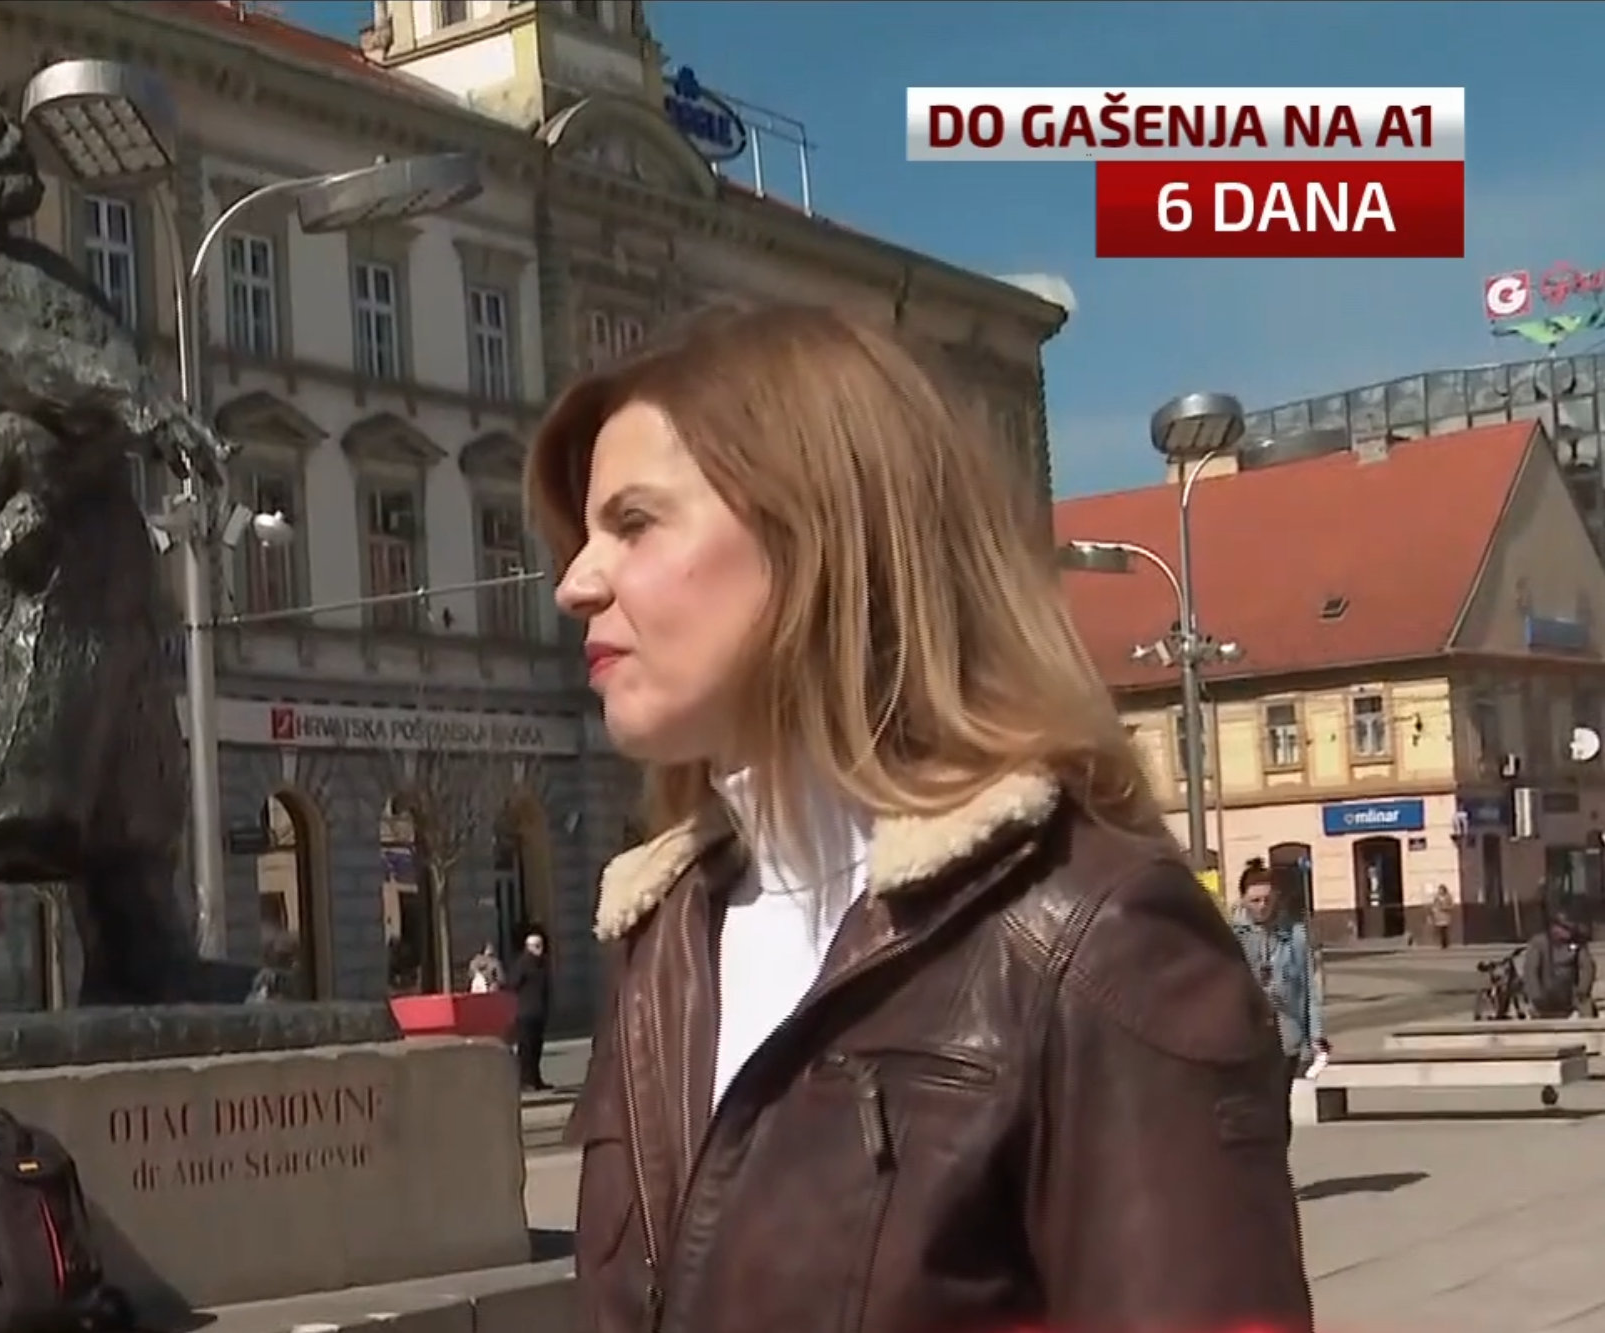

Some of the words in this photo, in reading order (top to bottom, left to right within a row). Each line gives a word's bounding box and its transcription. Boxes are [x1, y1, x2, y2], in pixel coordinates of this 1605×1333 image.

[295, 711, 388, 741] HRVATSKA
[1354, 807, 1400, 826] mlinar
[108, 1101, 193, 1145] OTAC
[214, 1083, 388, 1137] DOMOVINE
[171, 1154, 234, 1188] Ante
